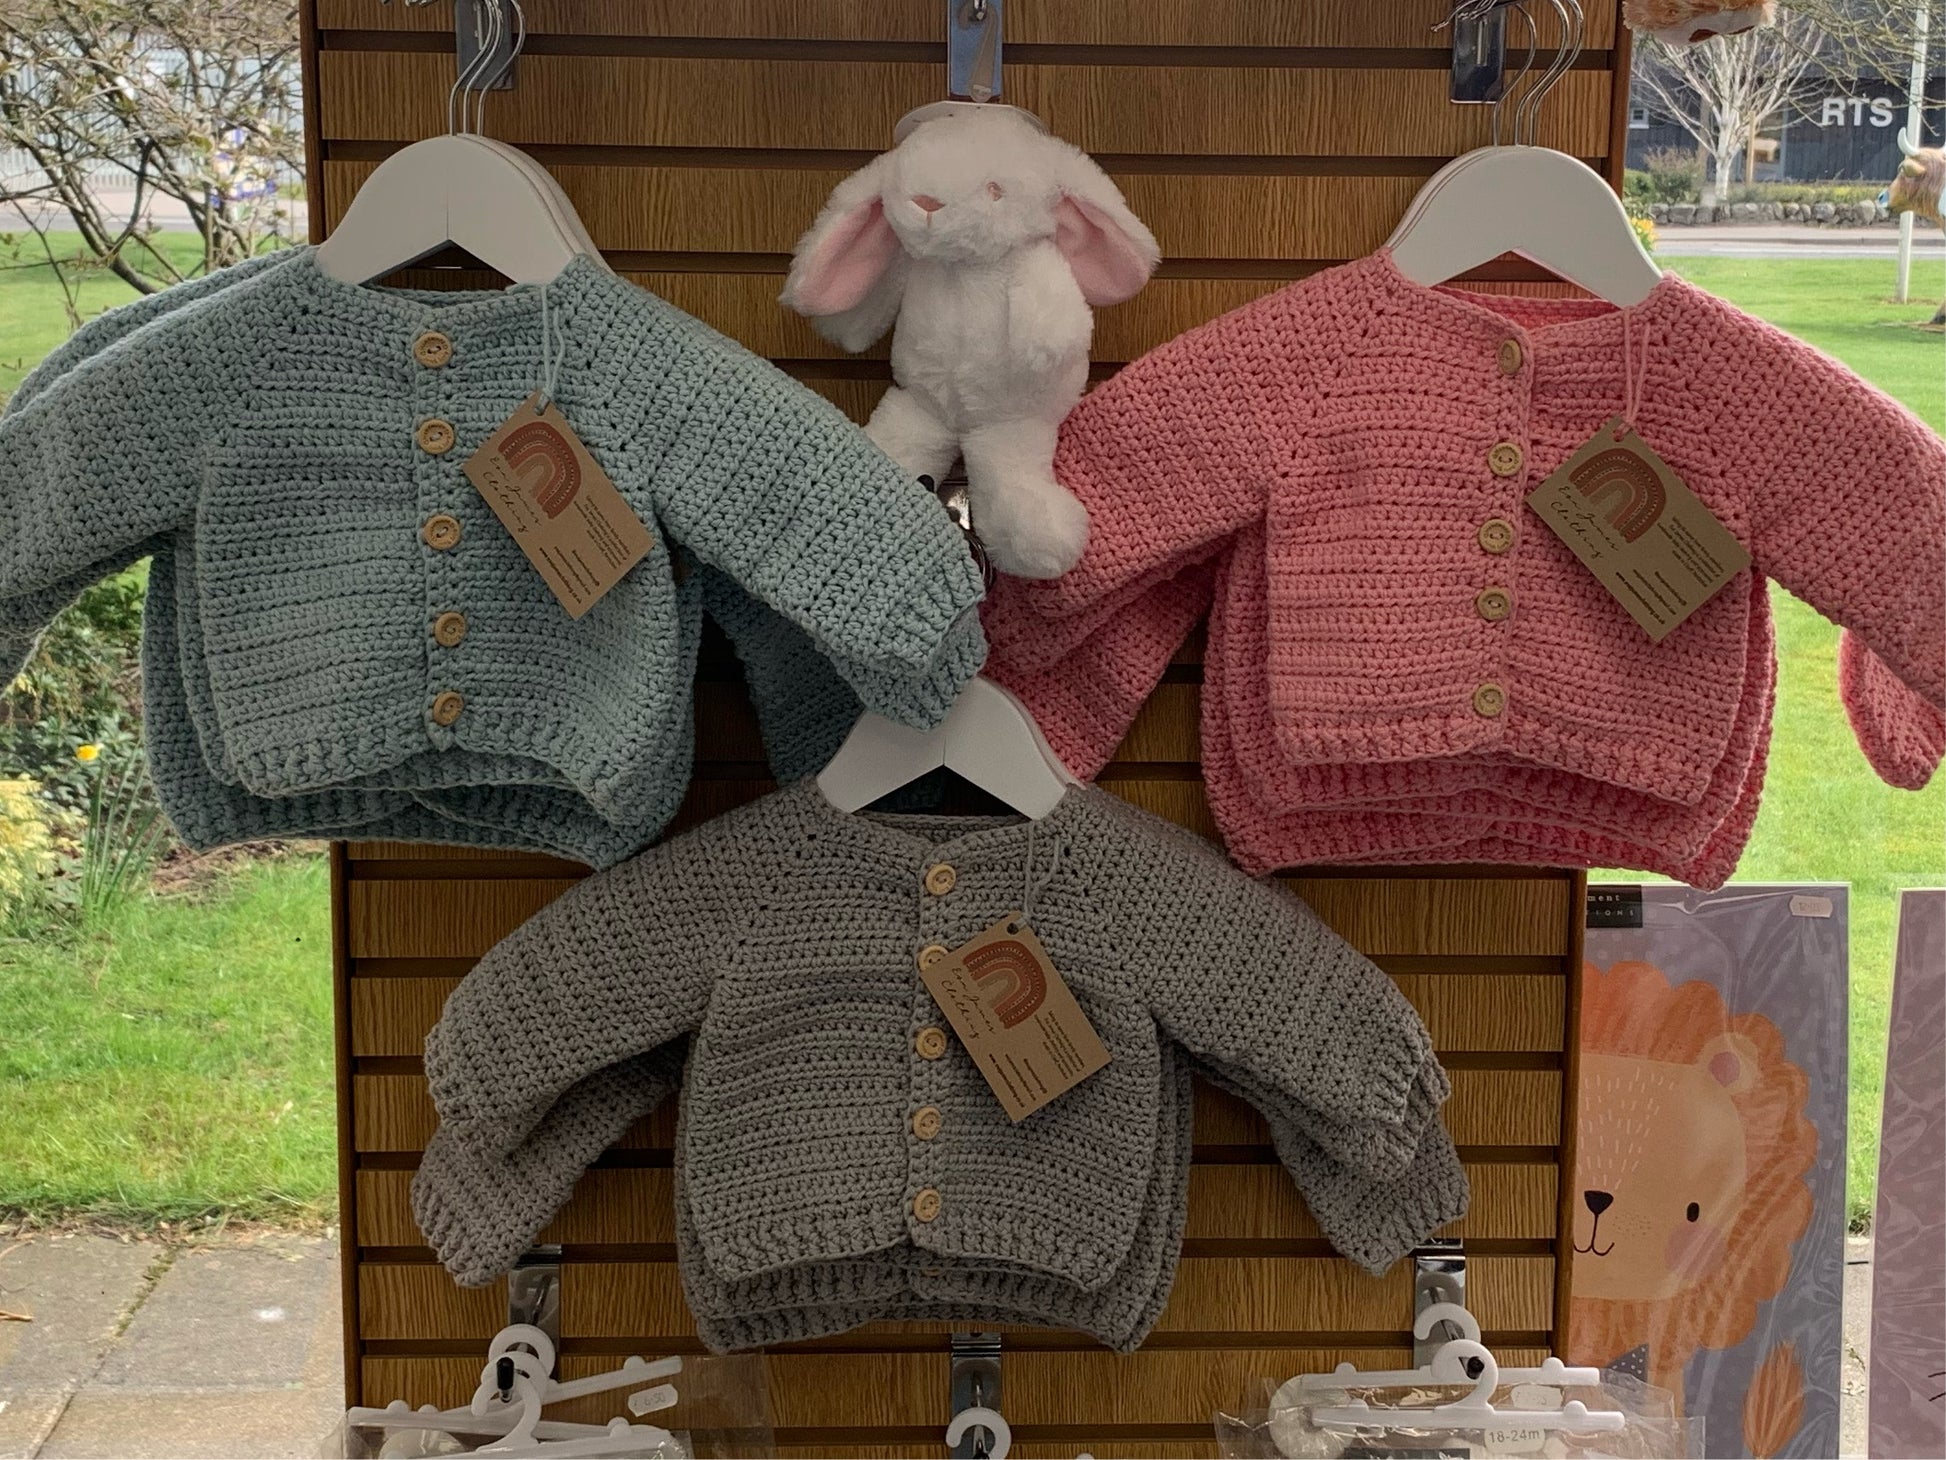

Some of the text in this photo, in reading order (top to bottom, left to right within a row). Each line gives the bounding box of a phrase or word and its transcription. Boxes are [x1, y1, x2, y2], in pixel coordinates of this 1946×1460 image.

[1823, 97, 1893, 127] RTS
[483, 472, 528, 533] Clothing
[1550, 502, 1604, 559] Clothing
[941, 980, 980, 1039] Clothing
[1489, 1429, 1541, 1444] 18-24m
